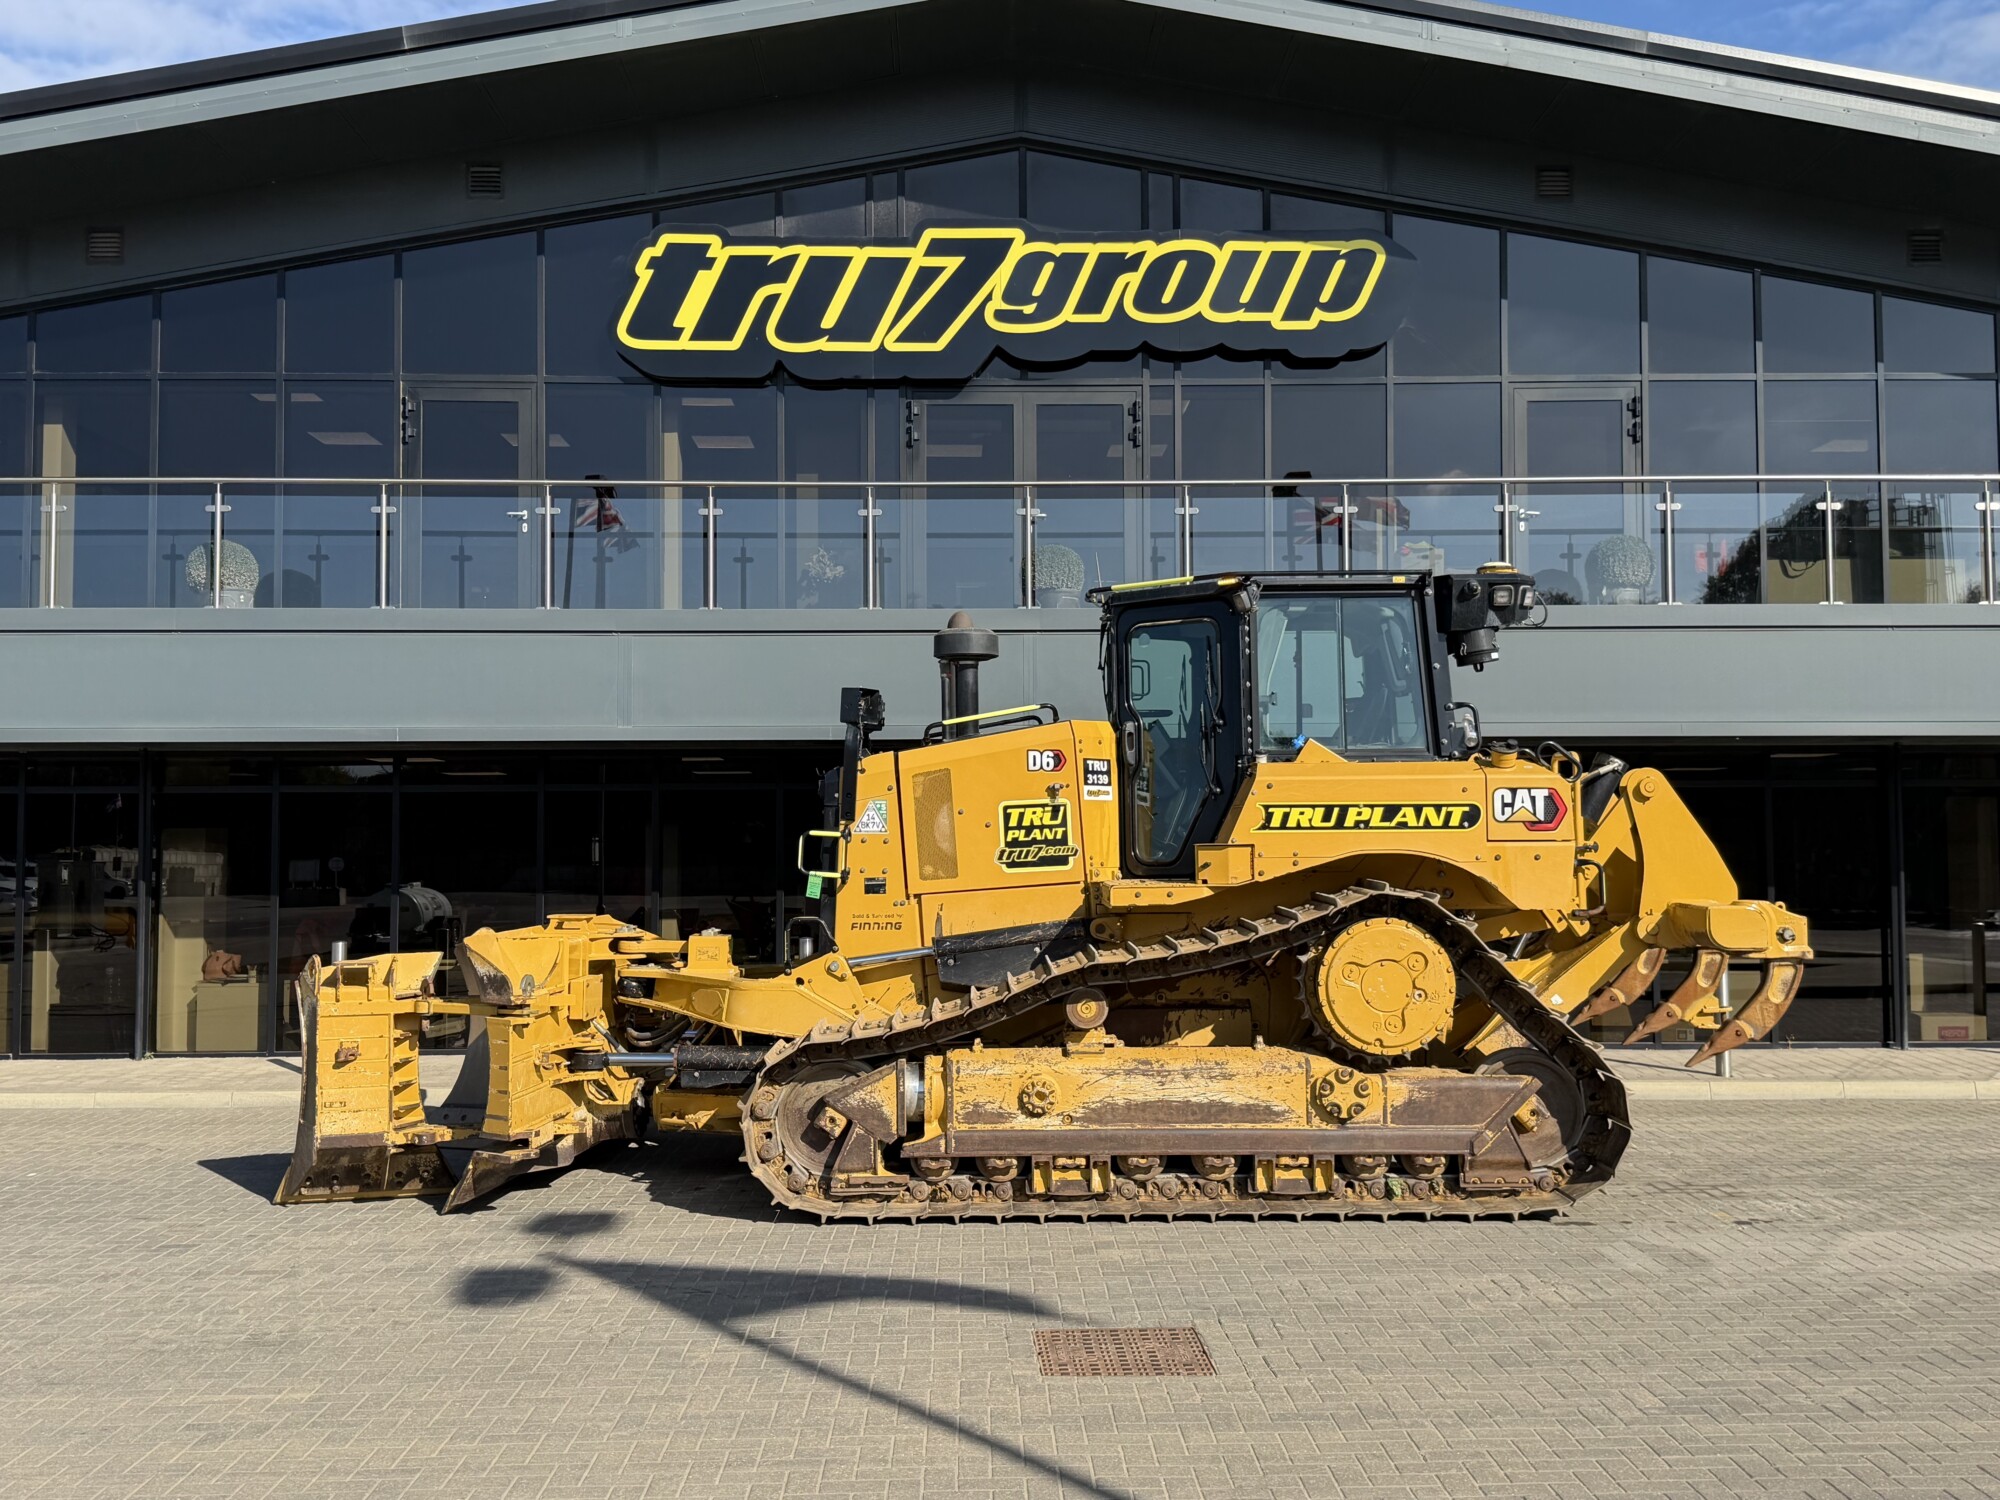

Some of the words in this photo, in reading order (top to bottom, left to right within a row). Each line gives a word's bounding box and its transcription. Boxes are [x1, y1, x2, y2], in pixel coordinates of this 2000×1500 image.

[617, 228, 1386, 352] tru7group
[1027, 750, 1055, 771] D6
[1086, 760, 1108, 771] TRU
[1086, 774, 1109, 784] 3139
[1493, 788, 1549, 822] CAT
[866, 813, 876, 821] 14
[1006, 806, 1065, 827] TRU
[1268, 807, 1340, 827] TRU
[1343, 806, 1470, 827] PLANT
[1006, 828, 1066, 842] PLANT
[995, 844, 1078, 863] tru7.com
